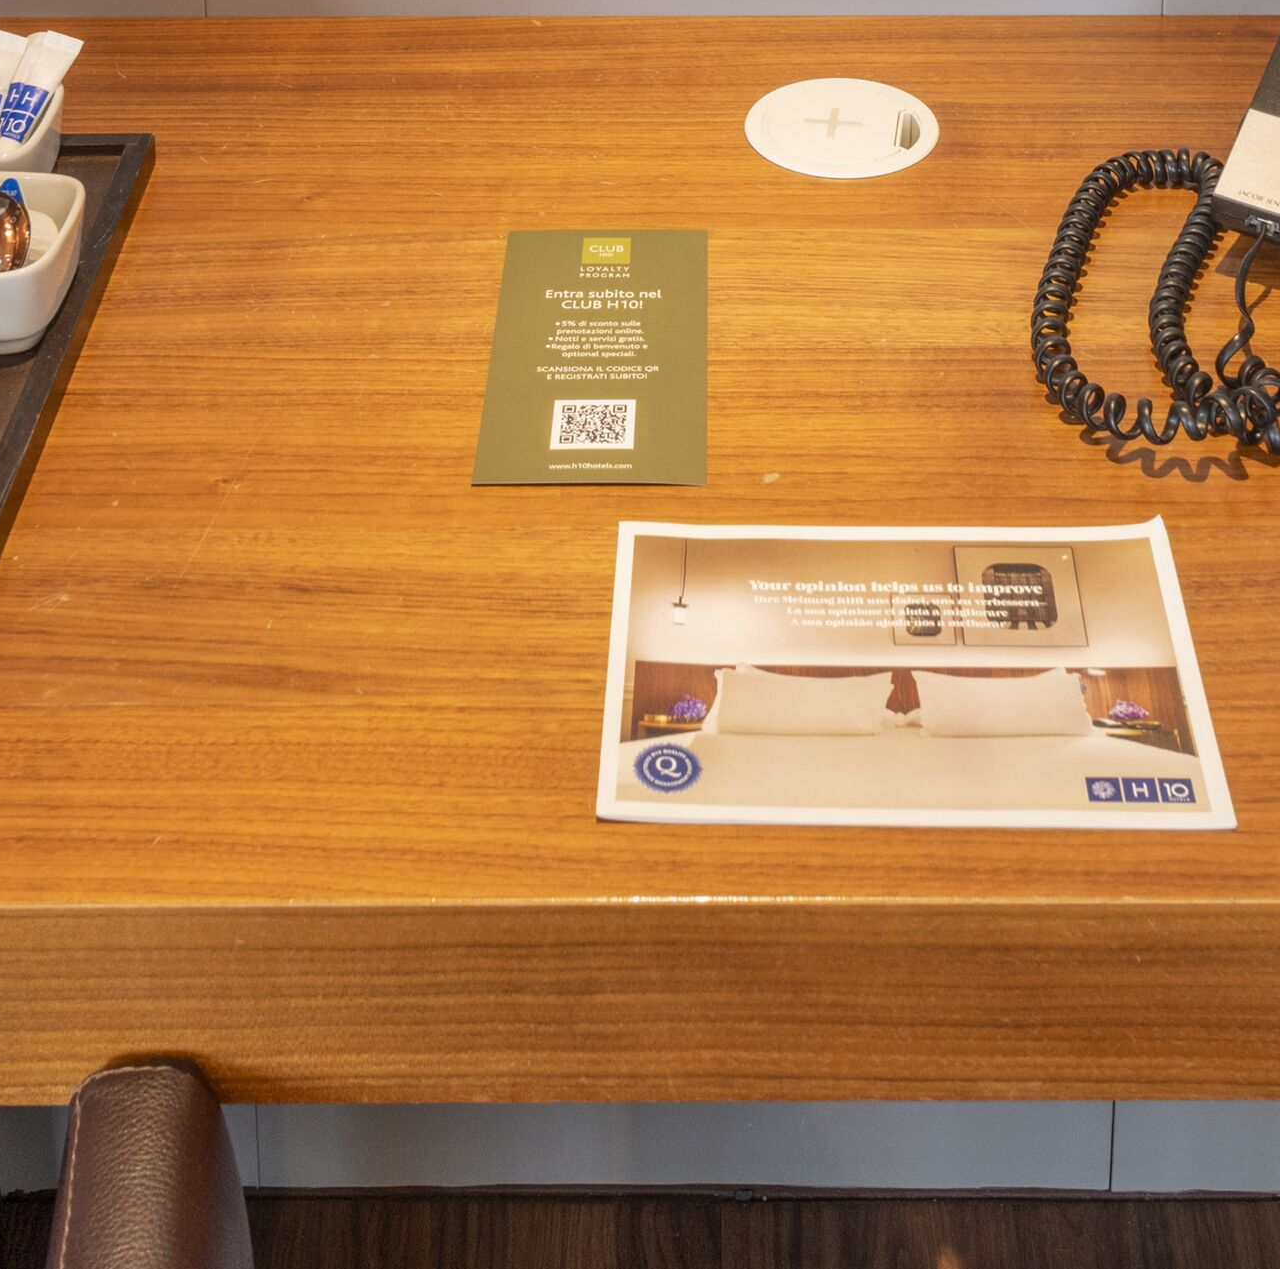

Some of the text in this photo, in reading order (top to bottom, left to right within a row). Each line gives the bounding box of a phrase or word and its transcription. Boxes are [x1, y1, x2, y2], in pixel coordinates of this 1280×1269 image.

[21, 91, 39, 107] H
[6, 117, 26, 133] 10
[1238, 190, 1264, 201] JACOB
[588, 245, 625, 253] CLUB
[545, 289, 662, 299] Entra subito nel
[561, 300, 644, 309] CLUB H10!
[748, 580, 1043, 596] Your opinion helps us to improve
[782, 595, 836, 606] Meinung
[866, 597, 890, 605] uns
[975, 598, 1040, 607] verbessern
[787, 607, 802, 615] La
[828, 607, 882, 617] opinione
[943, 608, 1009, 617] migliorare
[791, 618, 799, 626] A
[948, 620, 1007, 628] melhorar
[655, 756, 682, 778] Q
[1132, 782, 1190, 798] H 10
